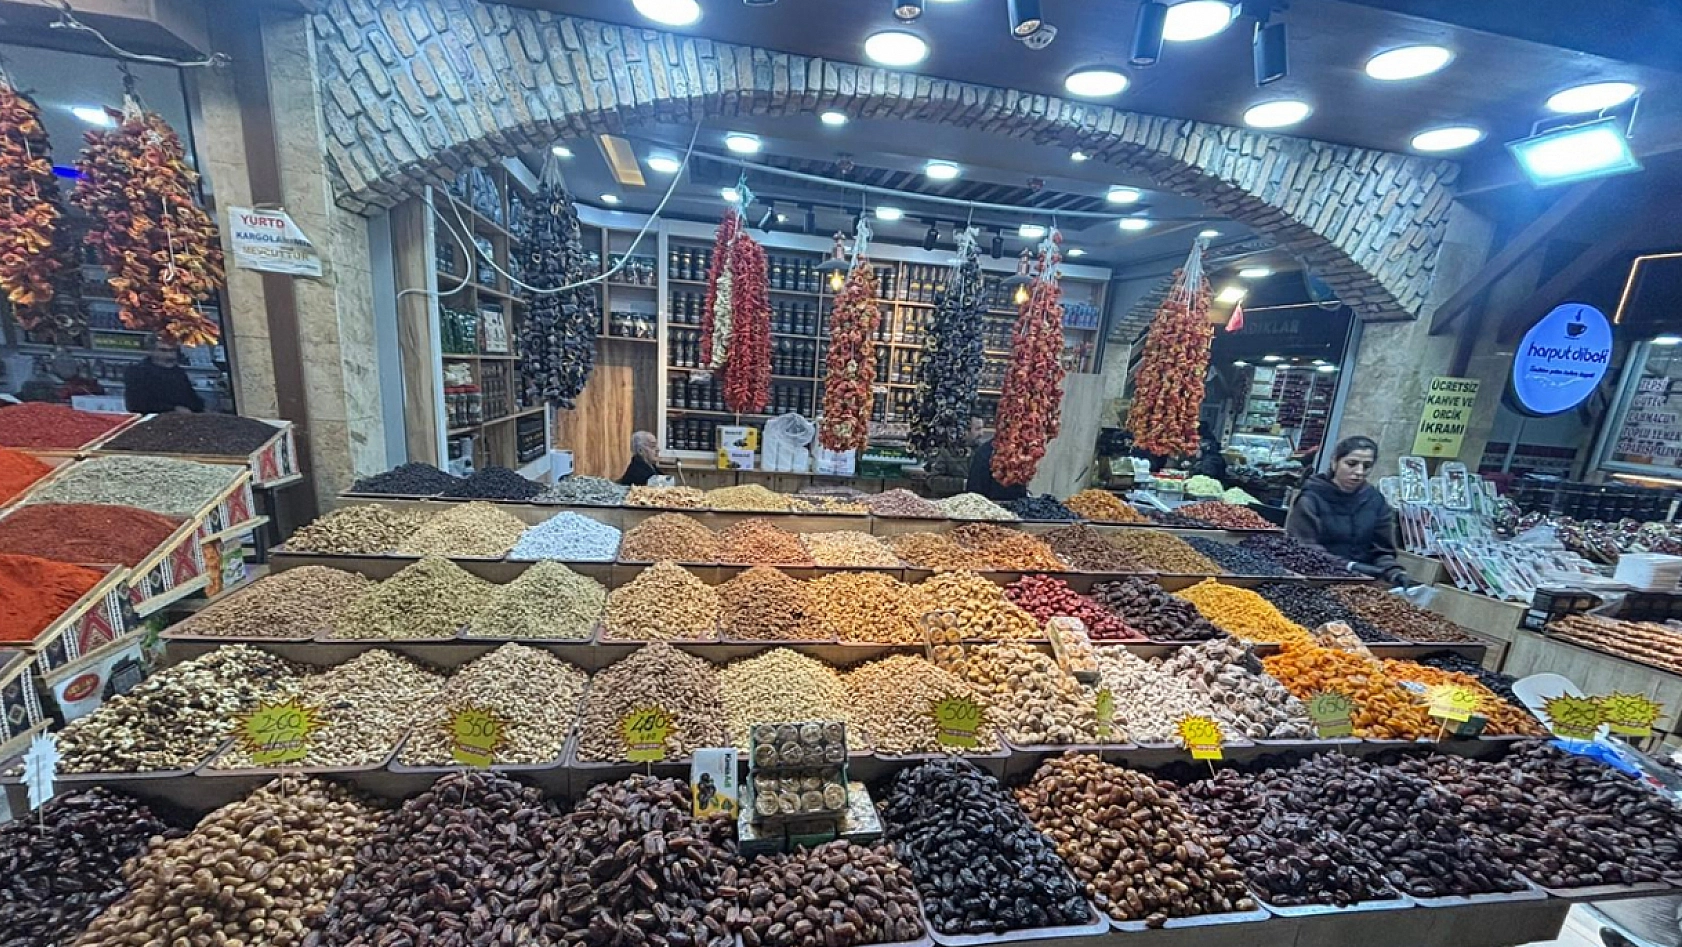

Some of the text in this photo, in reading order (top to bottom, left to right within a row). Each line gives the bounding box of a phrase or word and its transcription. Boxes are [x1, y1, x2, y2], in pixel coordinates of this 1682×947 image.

[1431, 378, 1478, 393] ÜCRETSİZ
[1427, 394, 1475, 408] KAHVE VE
[944, 703, 976, 720] 500
[256, 711, 301, 733] 260
[459, 714, 496, 737] 350
